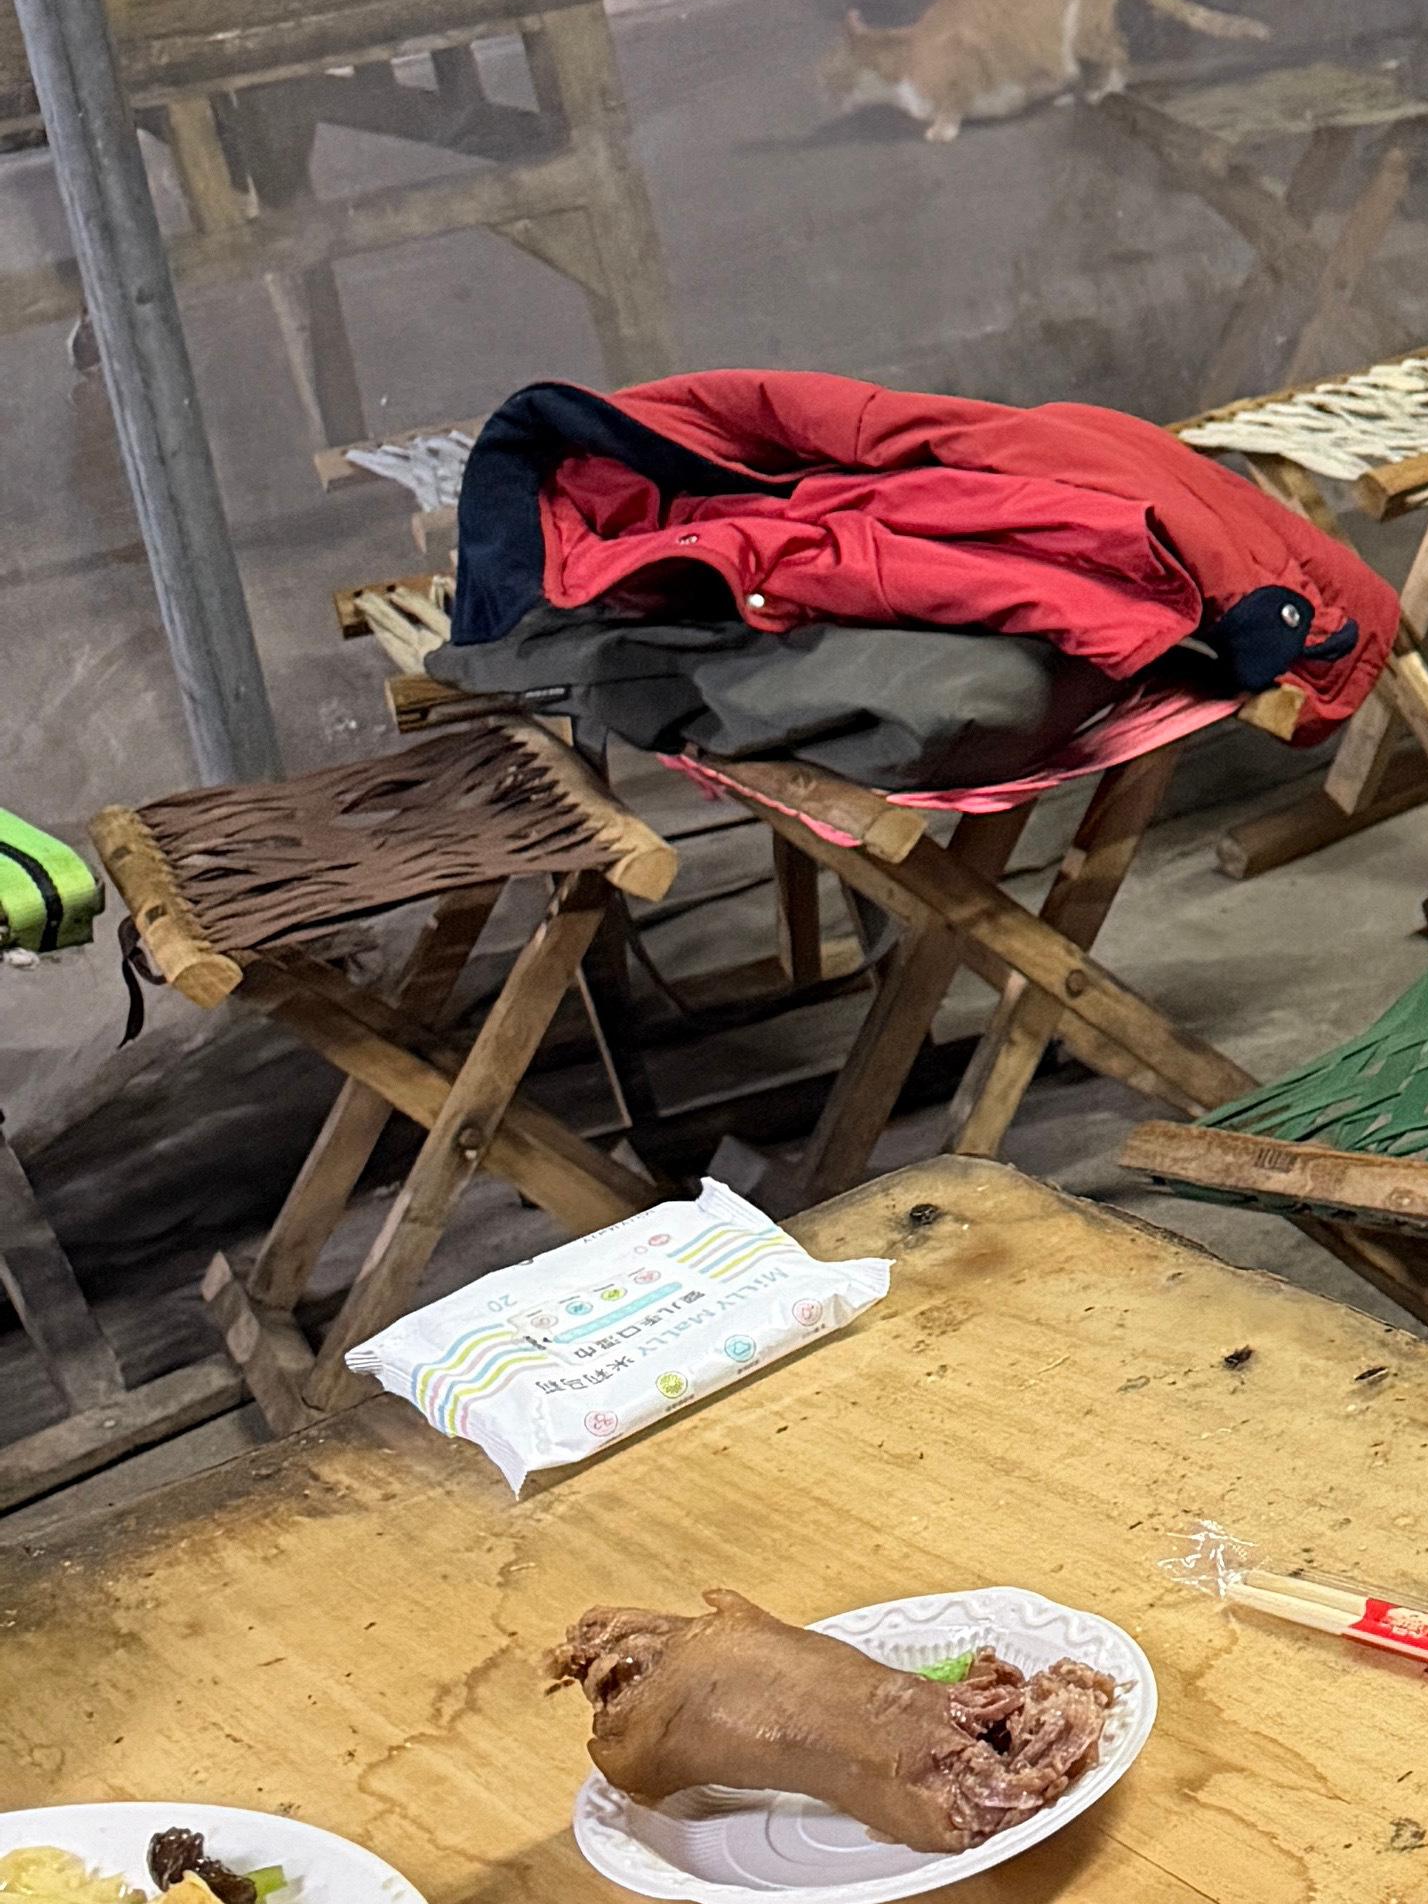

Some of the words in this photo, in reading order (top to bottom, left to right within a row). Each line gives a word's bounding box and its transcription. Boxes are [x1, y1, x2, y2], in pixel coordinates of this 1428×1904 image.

[574, 1289, 706, 1360] 婴儿手口湿巾
